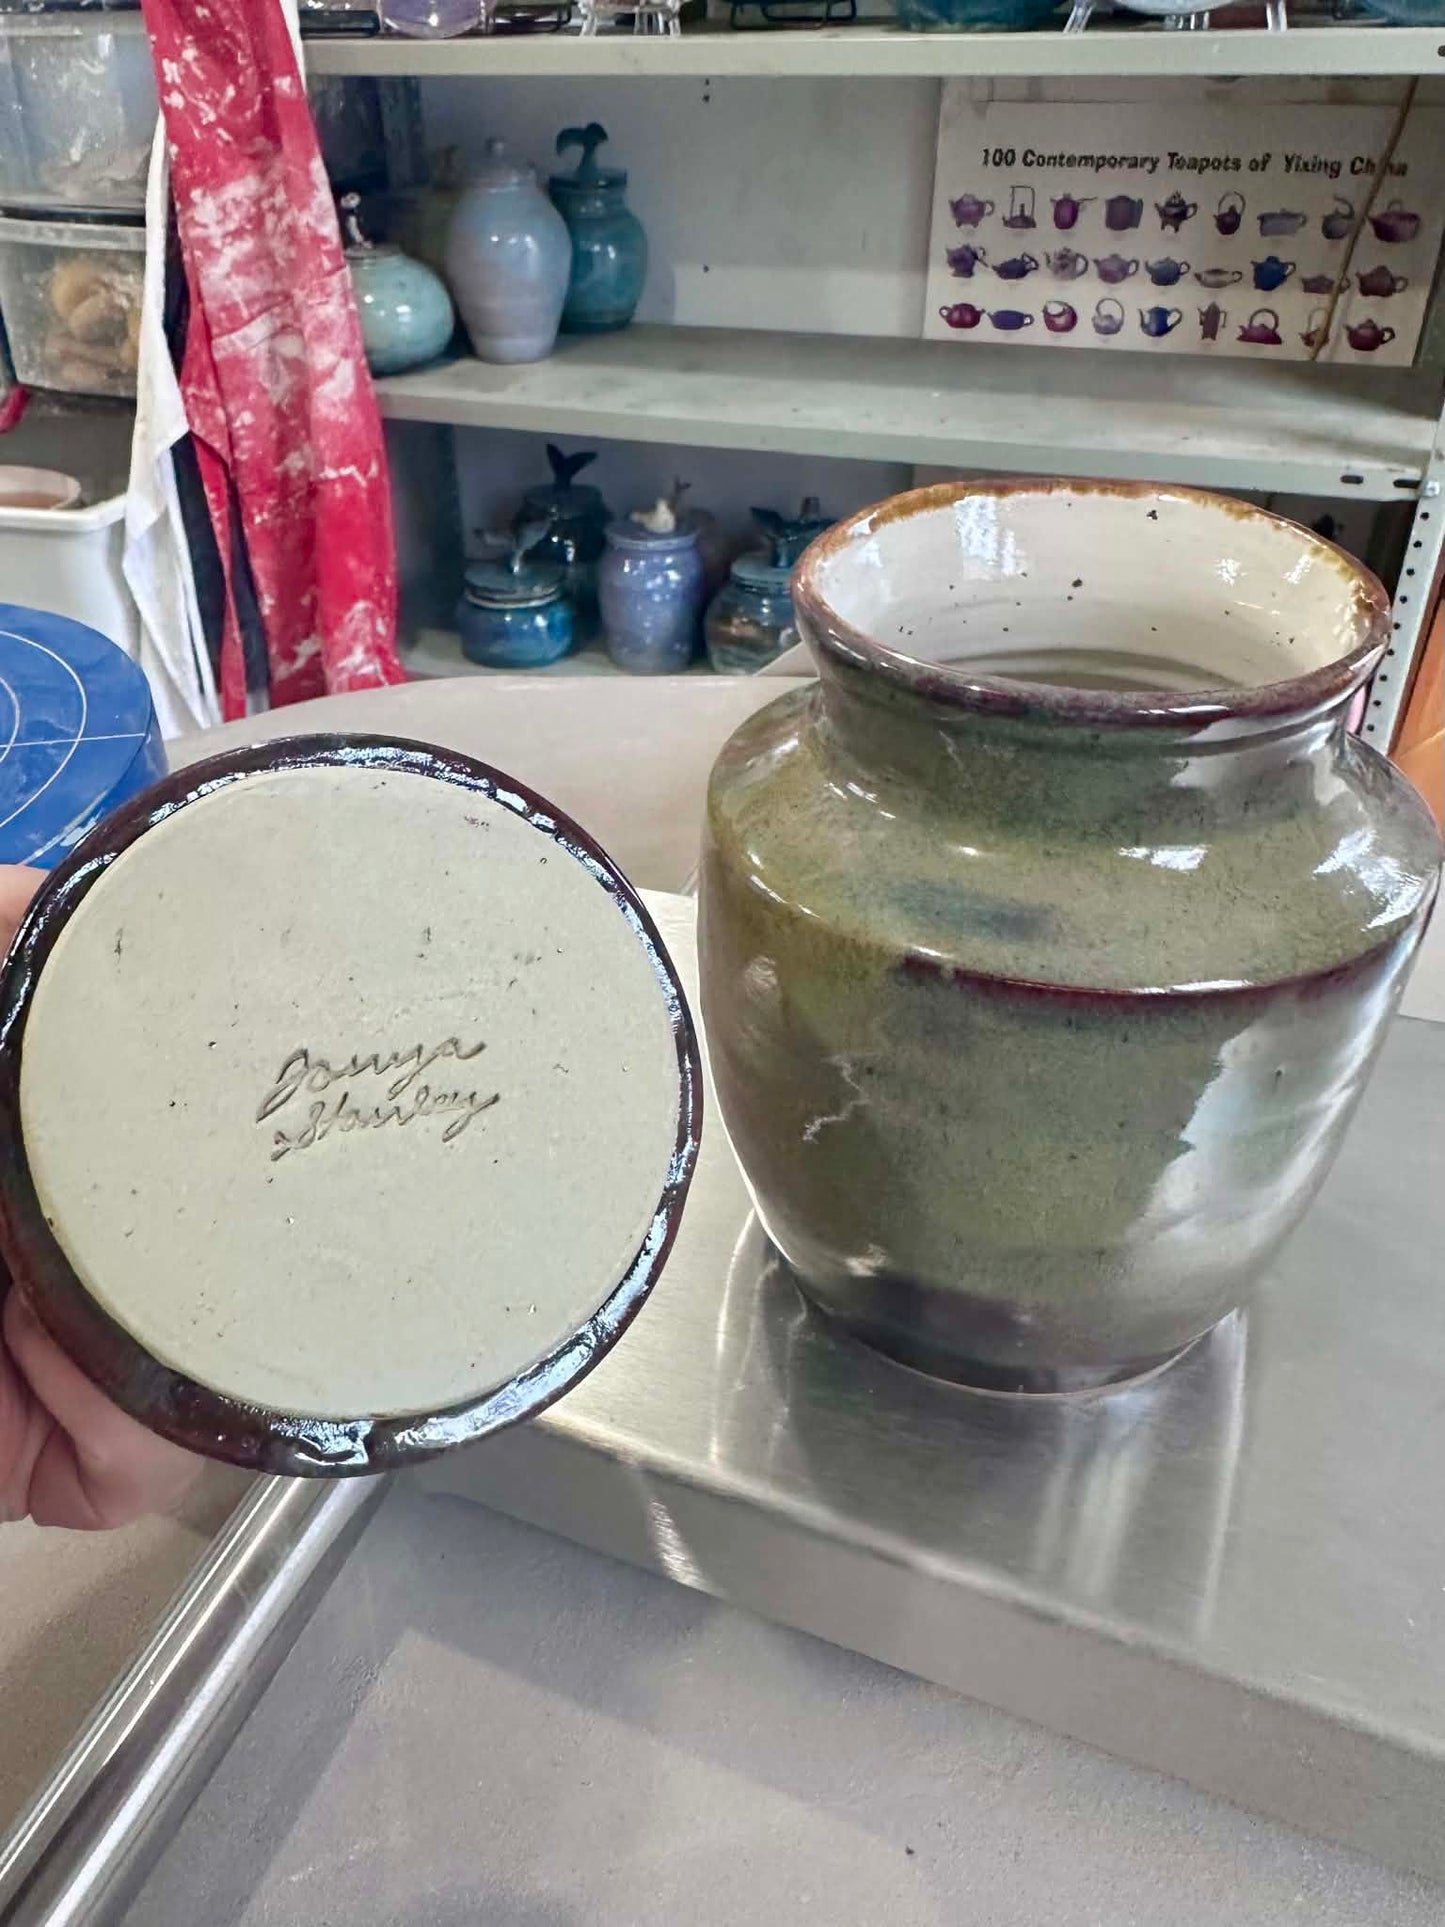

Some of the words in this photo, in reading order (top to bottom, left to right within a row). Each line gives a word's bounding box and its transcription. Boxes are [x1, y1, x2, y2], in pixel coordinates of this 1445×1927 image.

[983, 148, 1017, 167] 100
[1022, 148, 1160, 174] Contemporary
[1167, 152, 1242, 174] Teapots
[1247, 153, 1272, 172] of
[1284, 153, 1342, 179] Yixing
[1350, 156, 1408, 176] Chna
